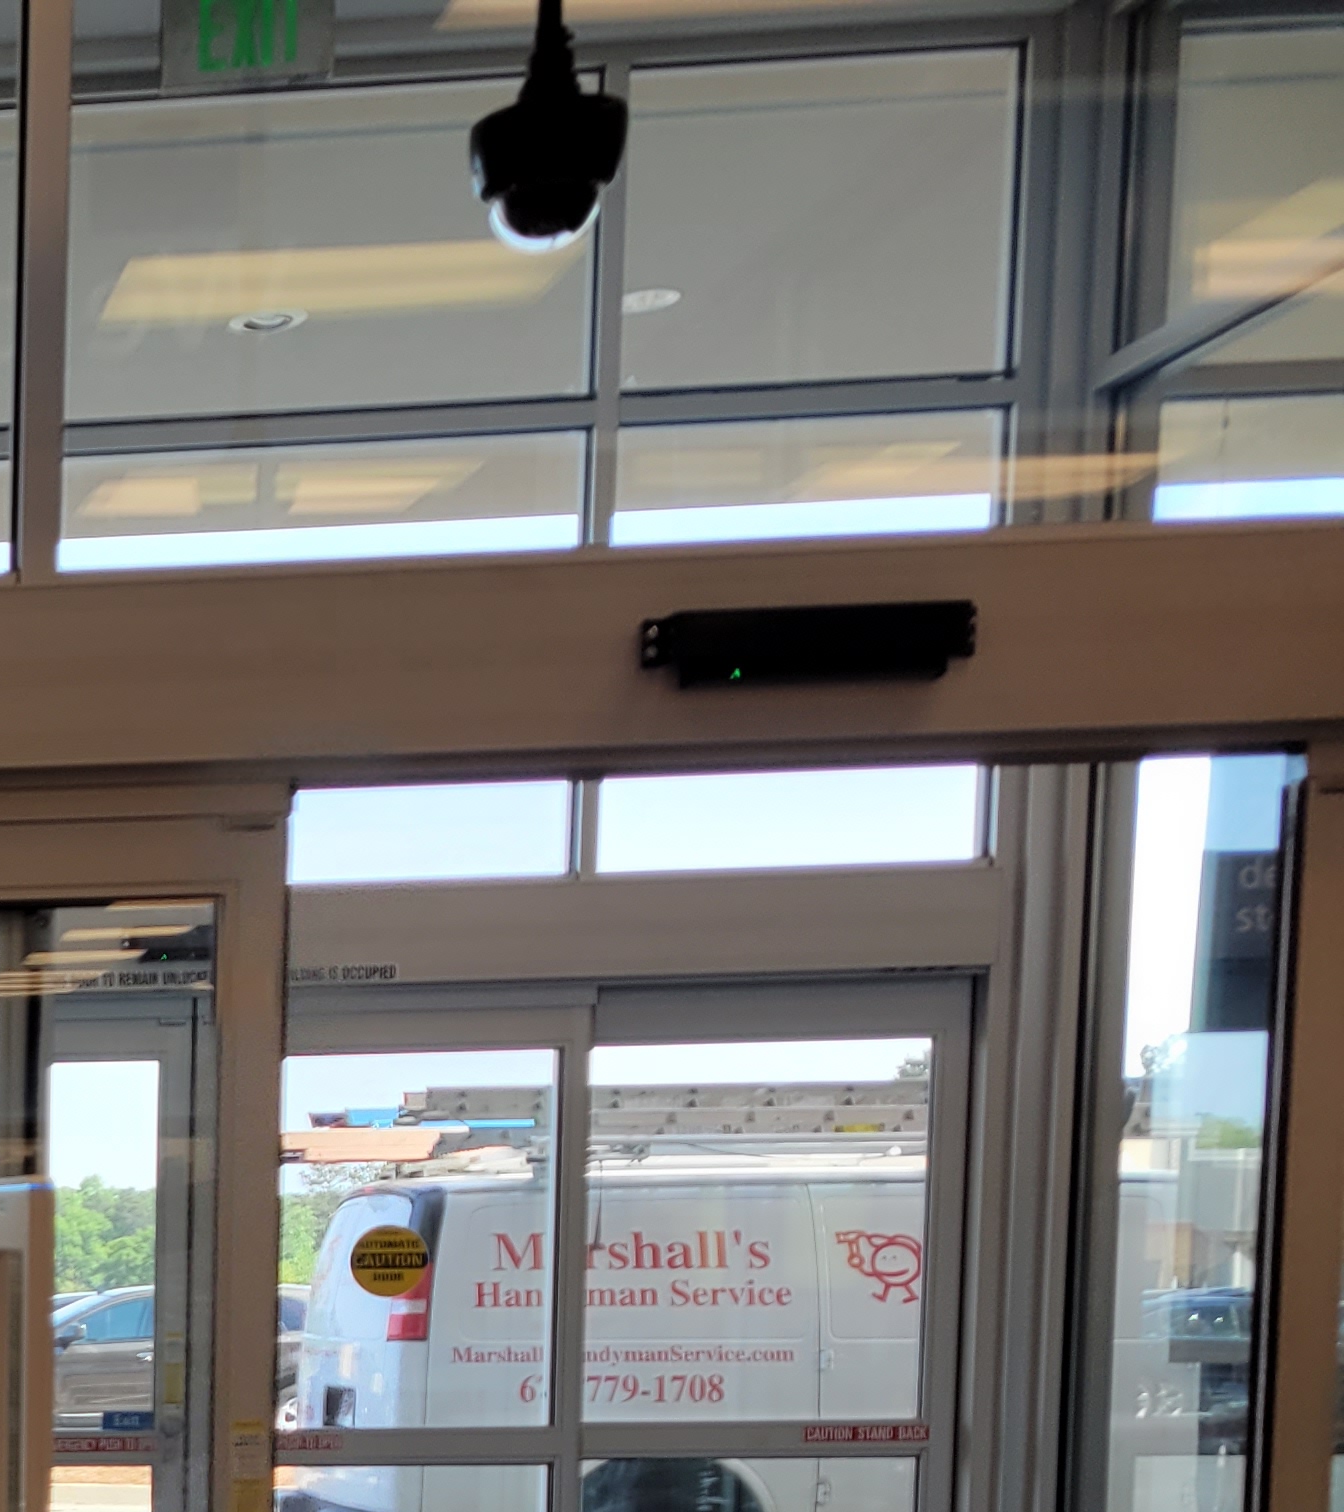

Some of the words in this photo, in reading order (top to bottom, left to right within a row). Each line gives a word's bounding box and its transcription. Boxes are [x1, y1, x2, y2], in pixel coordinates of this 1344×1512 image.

[491, 1228, 772, 1271] Mrshall's
[473, 1280, 660, 1308] Hanman
[669, 1278, 793, 1308] Service
[806, 1426, 853, 1440] CAUTION
[857, 1426, 894, 1440] STAND
